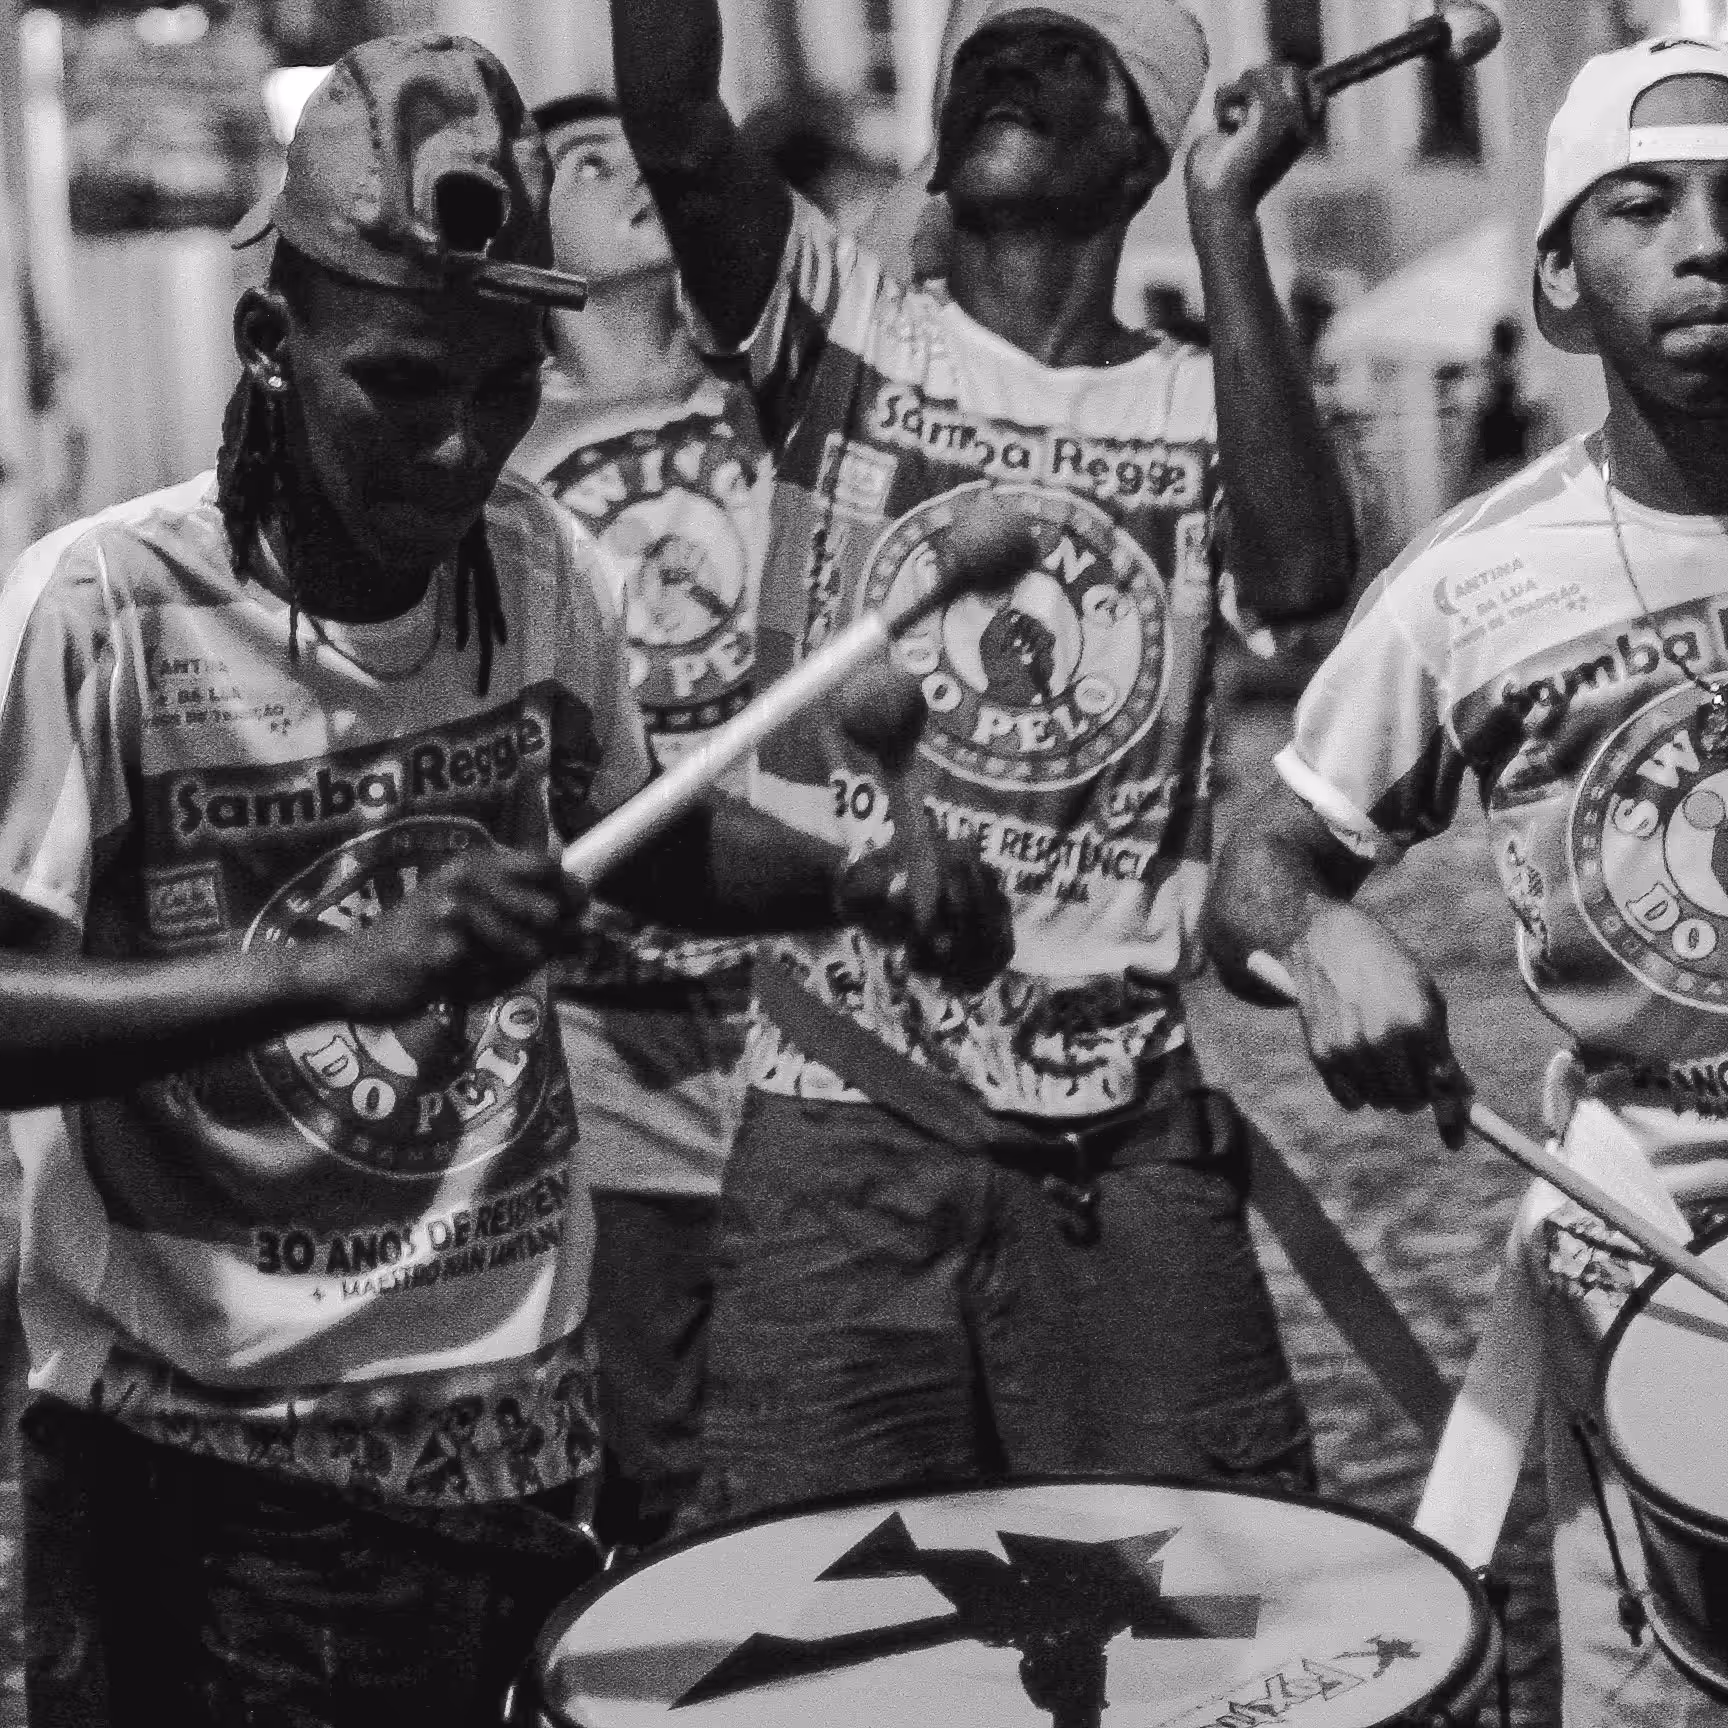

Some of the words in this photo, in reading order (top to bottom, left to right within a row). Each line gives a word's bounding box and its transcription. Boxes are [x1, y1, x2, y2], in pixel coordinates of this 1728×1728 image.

[176, 767, 399, 839] Samba
[1625, 881, 1717, 959] DO
[302, 1035, 397, 1122] DO
[256, 1229, 316, 1275] 30
